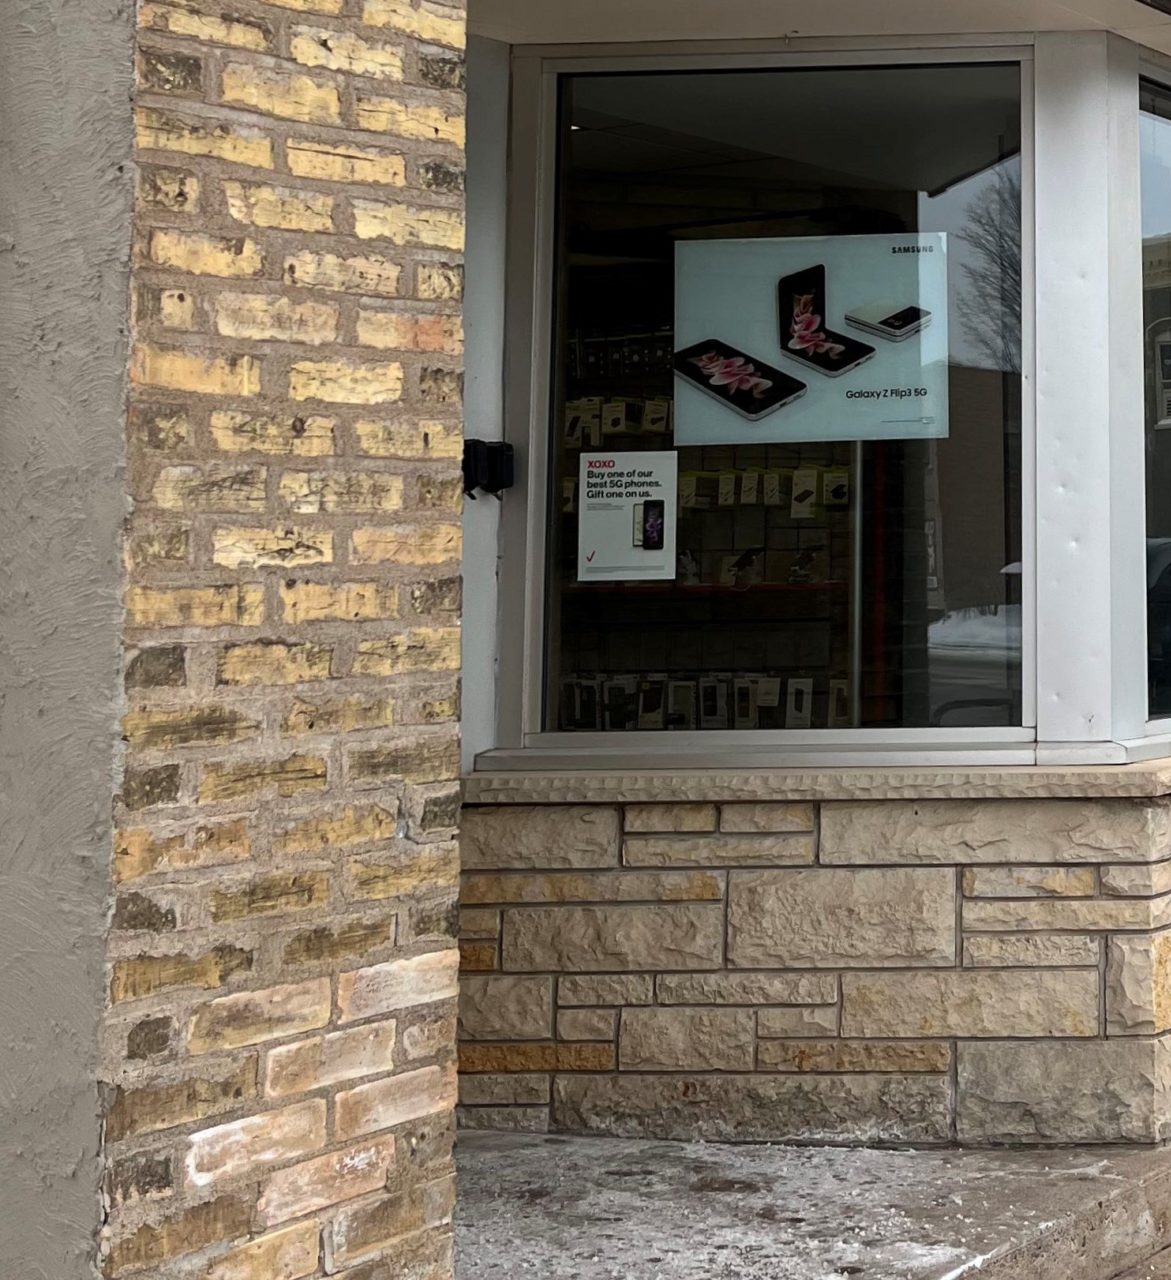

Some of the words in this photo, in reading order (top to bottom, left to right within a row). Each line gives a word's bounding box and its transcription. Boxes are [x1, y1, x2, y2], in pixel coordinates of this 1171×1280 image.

[891, 246, 934, 254] SAMSUNG
[846, 390, 881, 400] Galaxy
[882, 389, 888, 398] Z
[890, 388, 912, 400] Flip3
[914, 388, 928, 397] 5G
[587, 460, 616, 469] XOXO
[587, 470, 605, 480] Buy
[626, 469, 637, 478] of
[587, 480, 607, 489] best
[609, 480, 623, 488] 5G
[624, 480, 662, 489] phones.
[587, 490, 604, 499] Gift
[625, 490, 637, 498] on
[639, 490, 652, 498] us.
